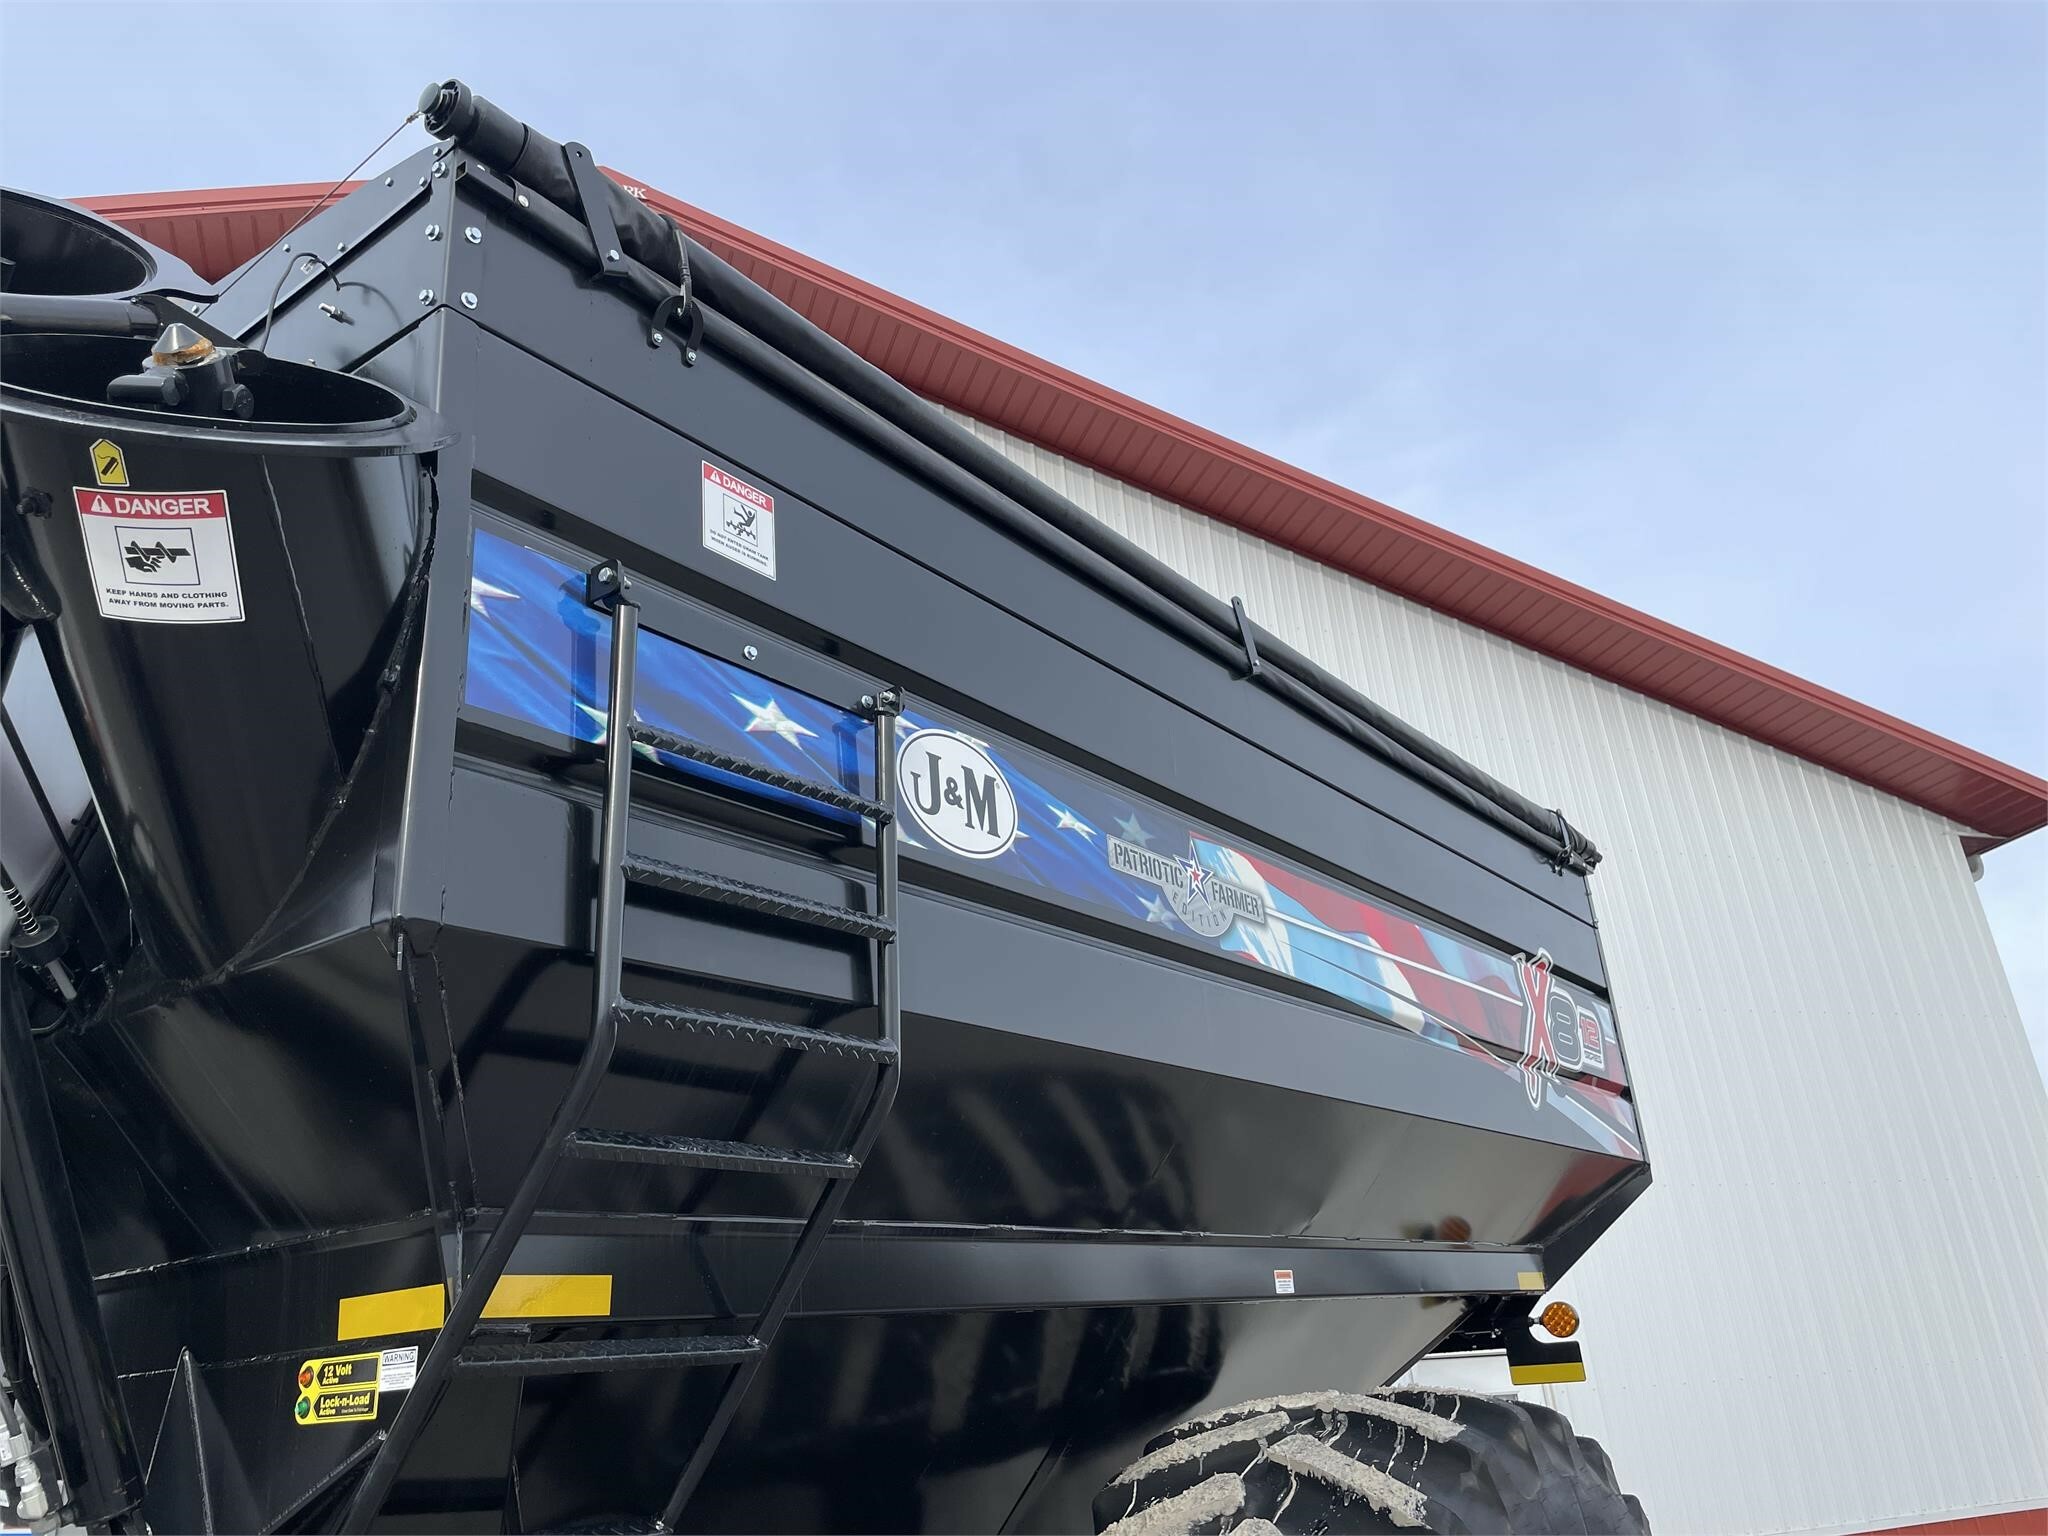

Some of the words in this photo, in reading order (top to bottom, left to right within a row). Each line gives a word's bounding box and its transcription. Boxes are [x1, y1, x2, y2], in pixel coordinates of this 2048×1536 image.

[723, 477, 767, 508] DANGER
[114, 497, 213, 515] DANGER
[106, 588, 127, 596] KEEP
[129, 590, 158, 598] HANDS
[181, 591, 228, 599] CLOTHING
[109, 598, 131, 606] AWAY
[133, 600, 157, 608] FROM
[910, 751, 1001, 839] J&M
[1113, 842, 1184, 889] PATRIOTIC
[1211, 880, 1261, 918] FARMER
[1172, 892, 1227, 928] EDITION
[384, 1351, 414, 1363] WARNING
[324, 1365, 334, 1377] 12
[335, 1363, 352, 1376] Volt
[322, 1377, 339, 1385] Active
[320, 1392, 371, 1408] Lock-n-Load
[319, 1408, 336, 1416] Active
